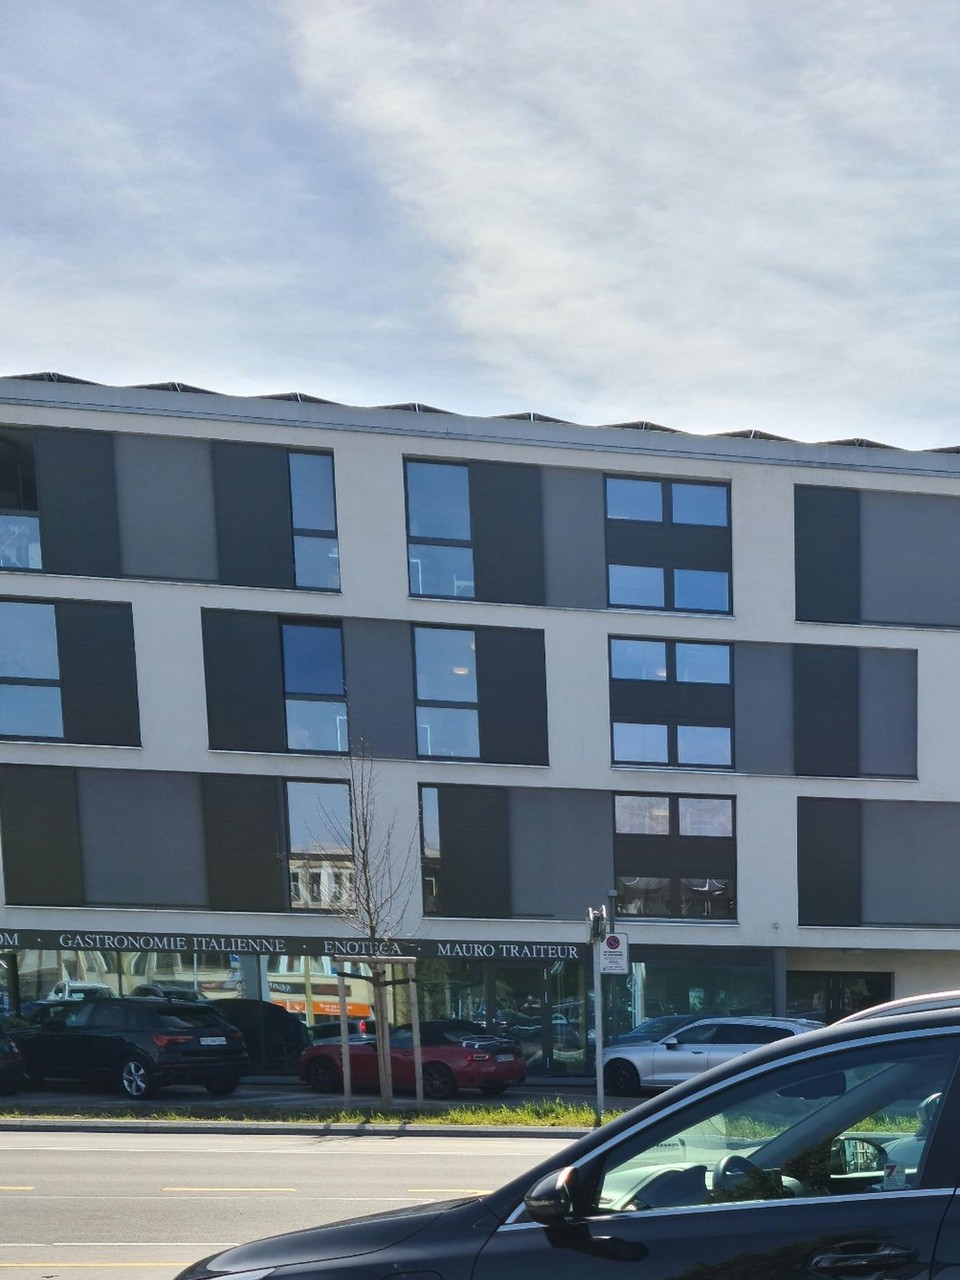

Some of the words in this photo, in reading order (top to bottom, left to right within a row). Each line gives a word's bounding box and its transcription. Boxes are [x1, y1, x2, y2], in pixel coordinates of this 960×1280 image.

[59, 934, 187, 950] GASTRONOMIE
[192, 937, 286, 952] ITALIENNE
[323, 940, 403, 955] ENOTECA
[437, 943, 495, 957] MAURO
[499, 944, 579, 958] TRAITEUR
